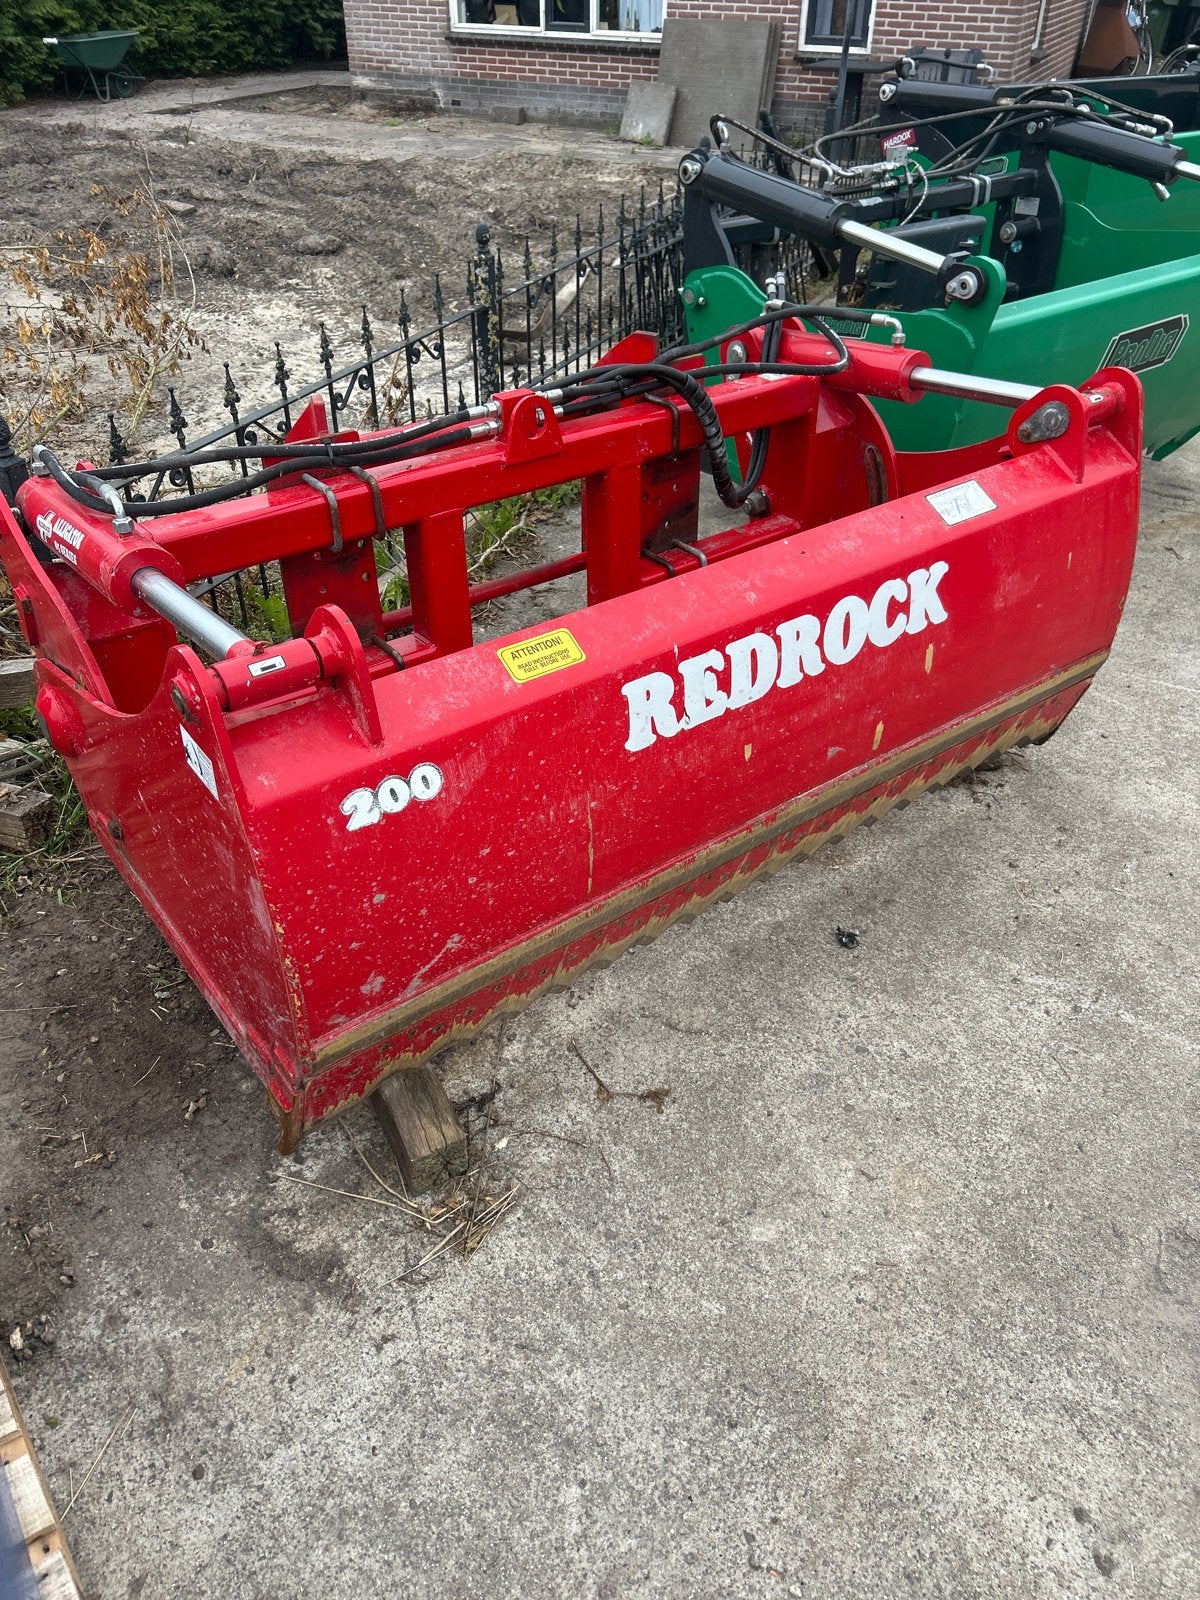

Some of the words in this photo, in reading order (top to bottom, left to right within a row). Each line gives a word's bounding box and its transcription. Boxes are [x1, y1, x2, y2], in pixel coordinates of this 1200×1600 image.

[883, 130, 912, 150] HARDOX
[511, 636, 563, 660] ATTENTION!
[518, 661, 532, 670] READ
[533, 648, 569, 664] INSTRUCTIONS
[621, 560, 949, 752] REDROCK
[524, 665, 538, 673] FULLY
[540, 659, 559, 667] BEFORE
[339, 762, 444, 832] 200
